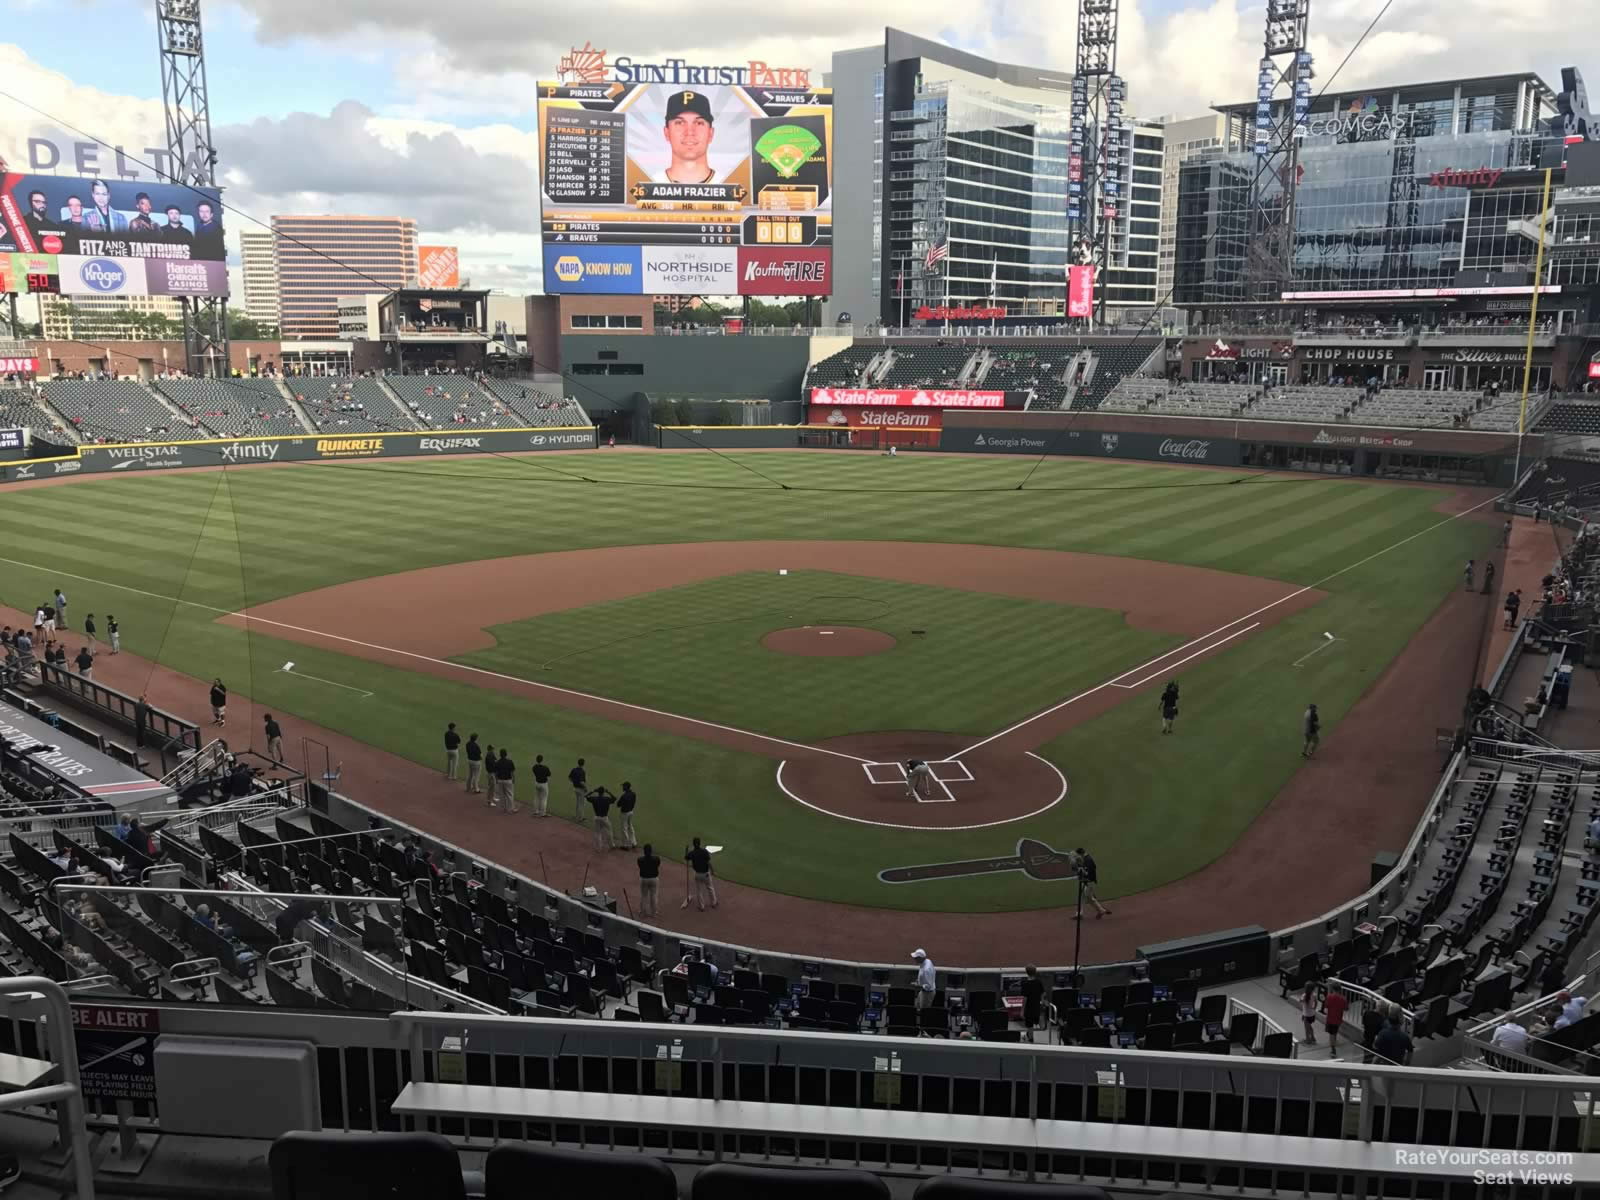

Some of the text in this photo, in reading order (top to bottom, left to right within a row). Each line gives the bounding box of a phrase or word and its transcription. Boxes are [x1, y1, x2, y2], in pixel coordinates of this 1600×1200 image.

[747, 60, 811, 88] PARK
[569, 89, 602, 98] PIRATES
[683, 92, 694, 105] P
[775, 94, 805, 103] BRAVES
[1310, 111, 1418, 137] COMCAST
[28, 137, 210, 185] DELTA
[1429, 166, 1502, 189] xfinity
[632, 187, 746, 198] 26 ADAM FRAZIER LF
[569, 223, 600, 231] PIRATES
[569, 234, 598, 242] BRAVES
[79, 239, 191, 259] FITZ AND THE TANTRUMS
[560, 263, 632, 274] NAPA KNOW HOW
[647, 262, 734, 272] NORTHSIDE
[784, 261, 825, 281] TIRE
[85, 263, 122, 288] Kroger
[1240, 348, 1271, 358] LIGHT
[1306, 348, 1394, 360] CHOP HOUSE
[1455, 348, 1503, 362] Silver
[1, 432, 17, 440] THE
[549, 434, 593, 444] HYUNDAI
[316, 438, 383, 452] QUIKRETE
[420, 437, 481, 451] EQUIFAX
[988, 437, 1045, 448] Georgia Power
[109, 446, 179, 459] WELLSTAR
[221, 442, 280, 463] xfinity
[71, 1009, 149, 1028] BE ALERT
[112, 1073, 128, 1081] MAY
[130, 1074, 155, 1082] LEAVE
[96, 1081, 129, 1089] PLAYING
[131, 1083, 154, 1091] FIELD
[103, 1089, 129, 1097] CAUSE
